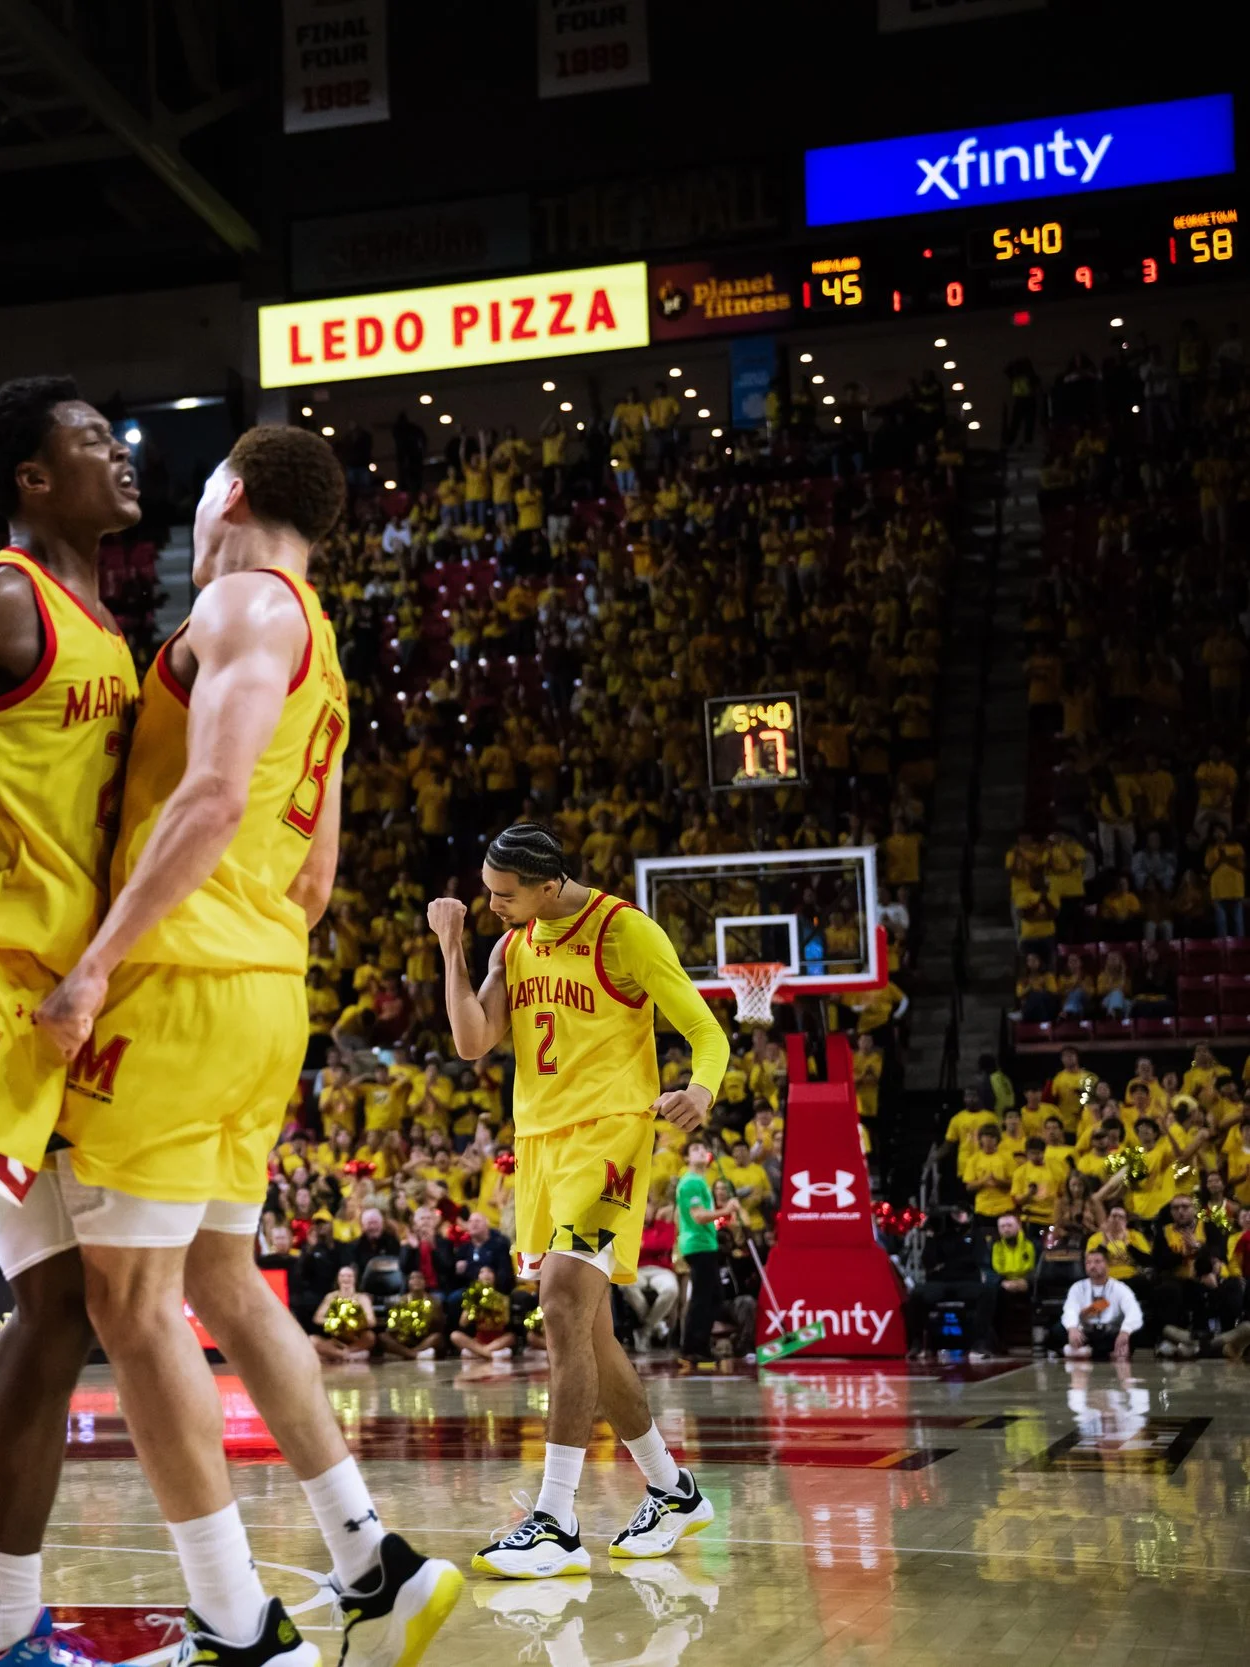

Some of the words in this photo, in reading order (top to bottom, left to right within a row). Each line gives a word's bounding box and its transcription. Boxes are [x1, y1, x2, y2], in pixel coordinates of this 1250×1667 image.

[296, 17, 371, 46] FINAL
[556, 5, 626, 34] FOUR
[302, 42, 369, 70] FOUR
[916, 128, 1113, 200] xfinity
[1173, 209, 1238, 230] GEORGETOWN
[993, 222, 1062, 260] 5:40
[1190, 228, 1233, 263] 58
[1027, 266, 1045, 292] 2
[1075, 266, 1093, 289] 9
[1142, 257, 1158, 284] 3
[693, 273, 774, 305] planet
[822, 274, 862, 305] 45
[946, 281, 963, 307] 0
[705, 293, 791, 319] fitness
[290, 311, 424, 365] LEDO
[453, 289, 616, 347] PIZZA
[732, 702, 791, 733] 5:40
[744, 730, 786, 776] 17
[535, 1011, 558, 1075] 2
[765, 1299, 893, 1345] xfinity
